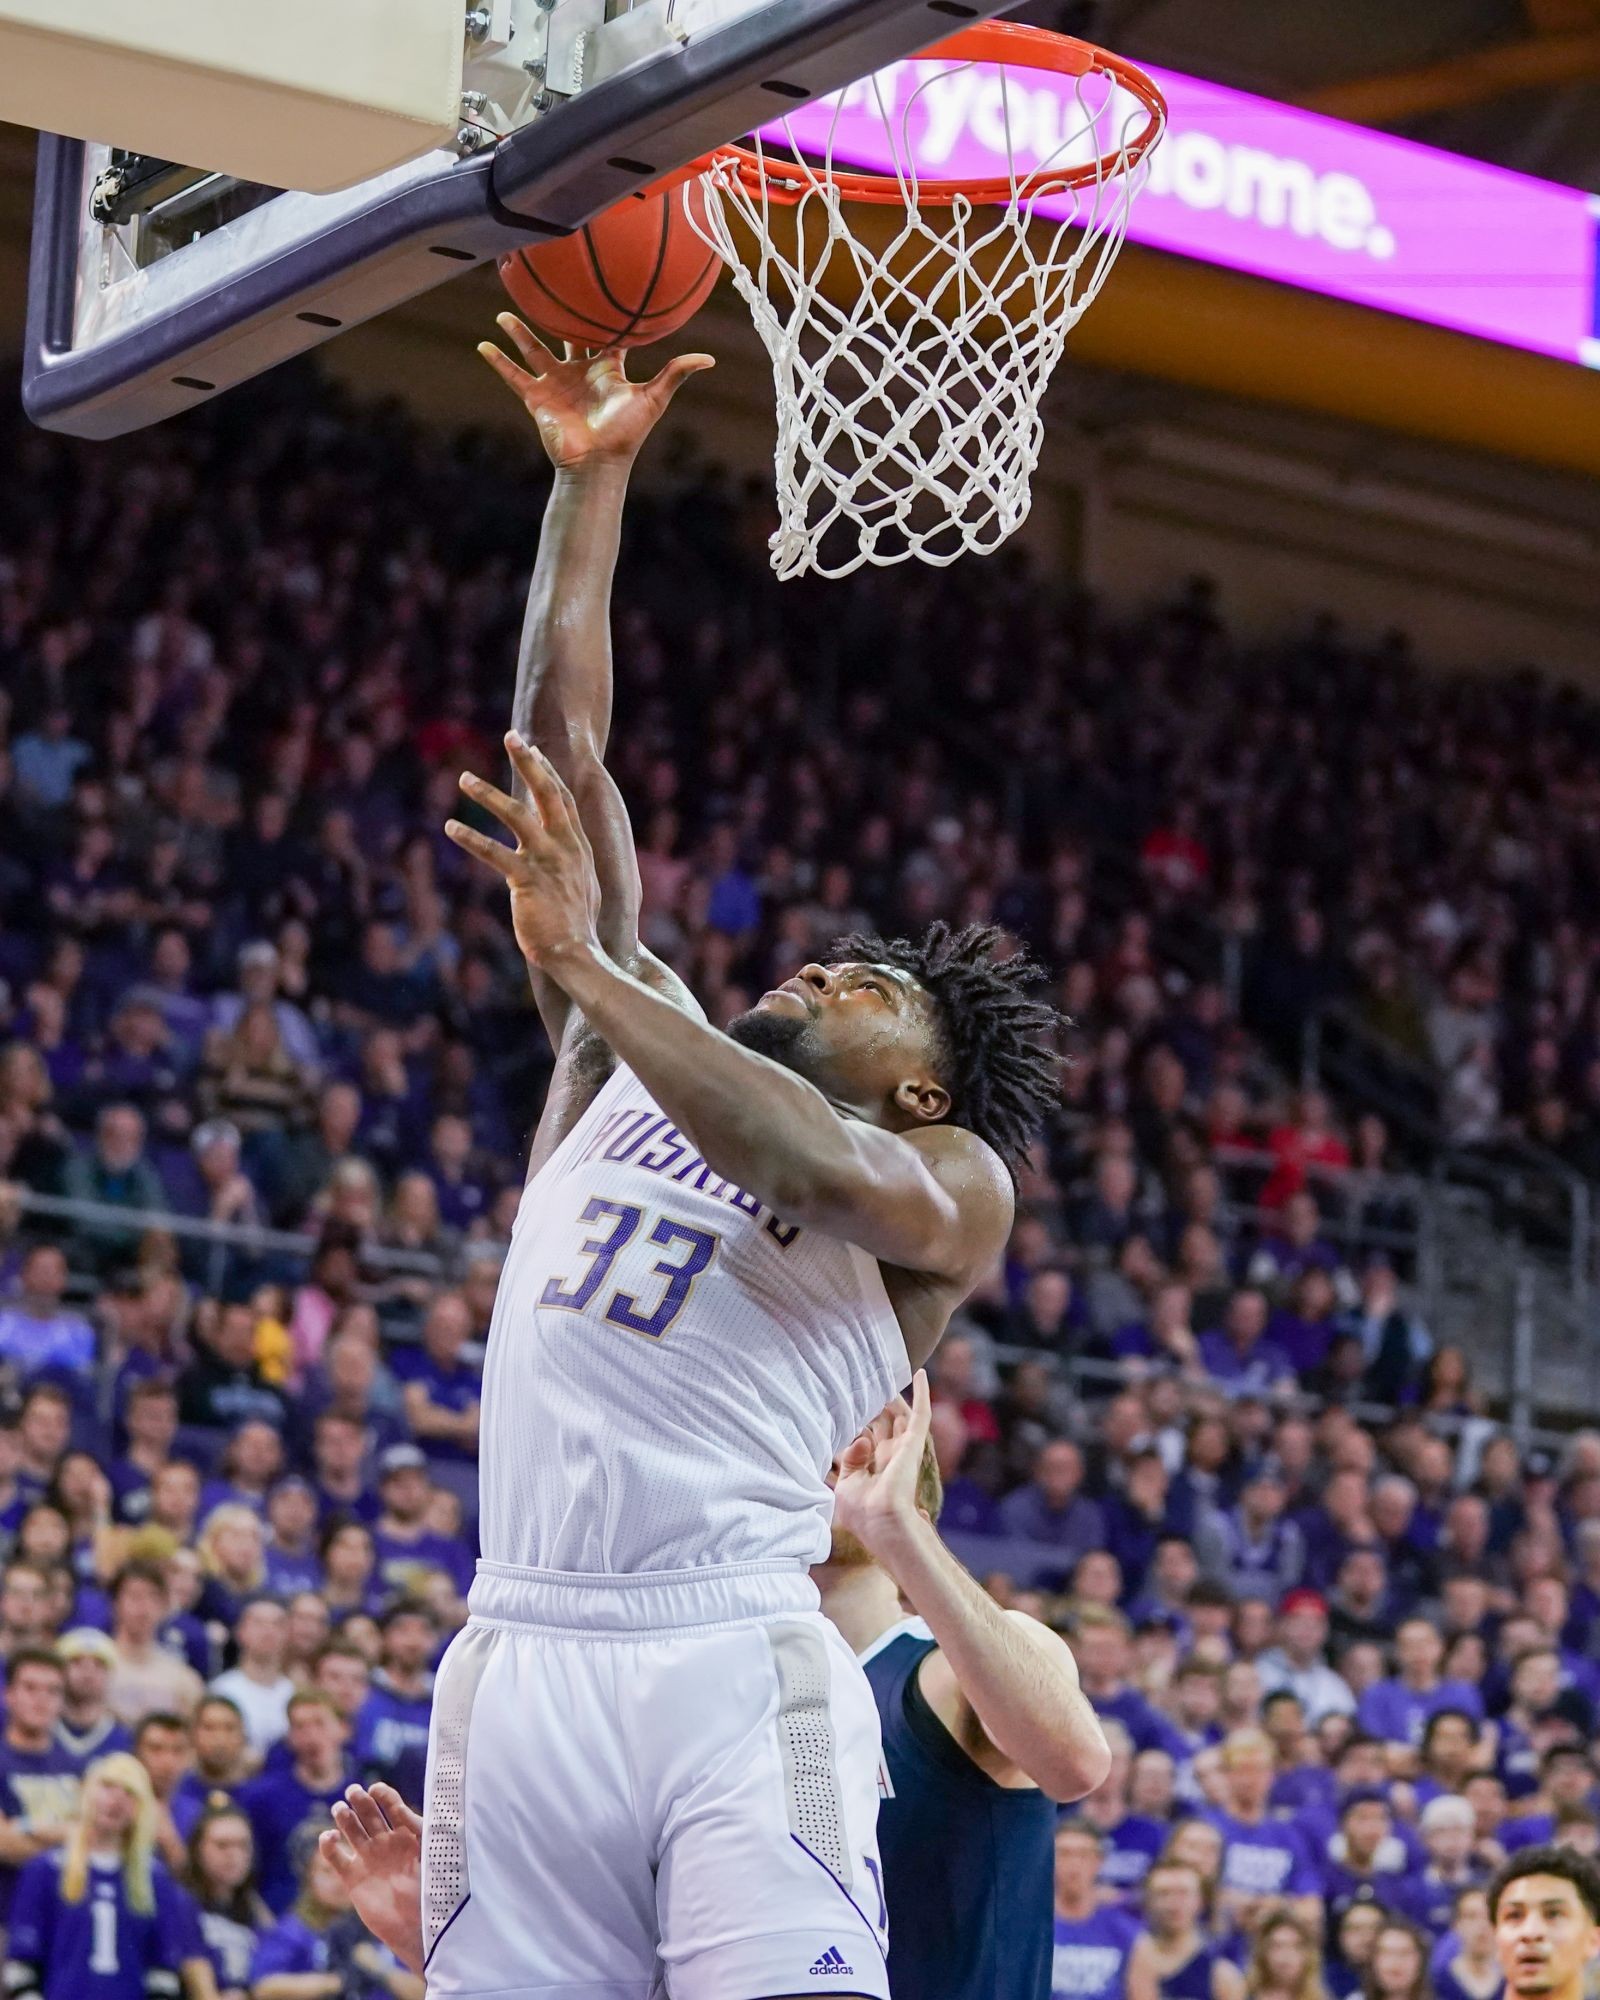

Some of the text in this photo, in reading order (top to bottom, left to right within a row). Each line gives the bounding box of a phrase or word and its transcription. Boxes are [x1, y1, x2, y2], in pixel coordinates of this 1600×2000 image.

[914, 60, 1093, 168] you
[537, 1196, 720, 1342] 33
[809, 1964, 854, 1975] adidas
